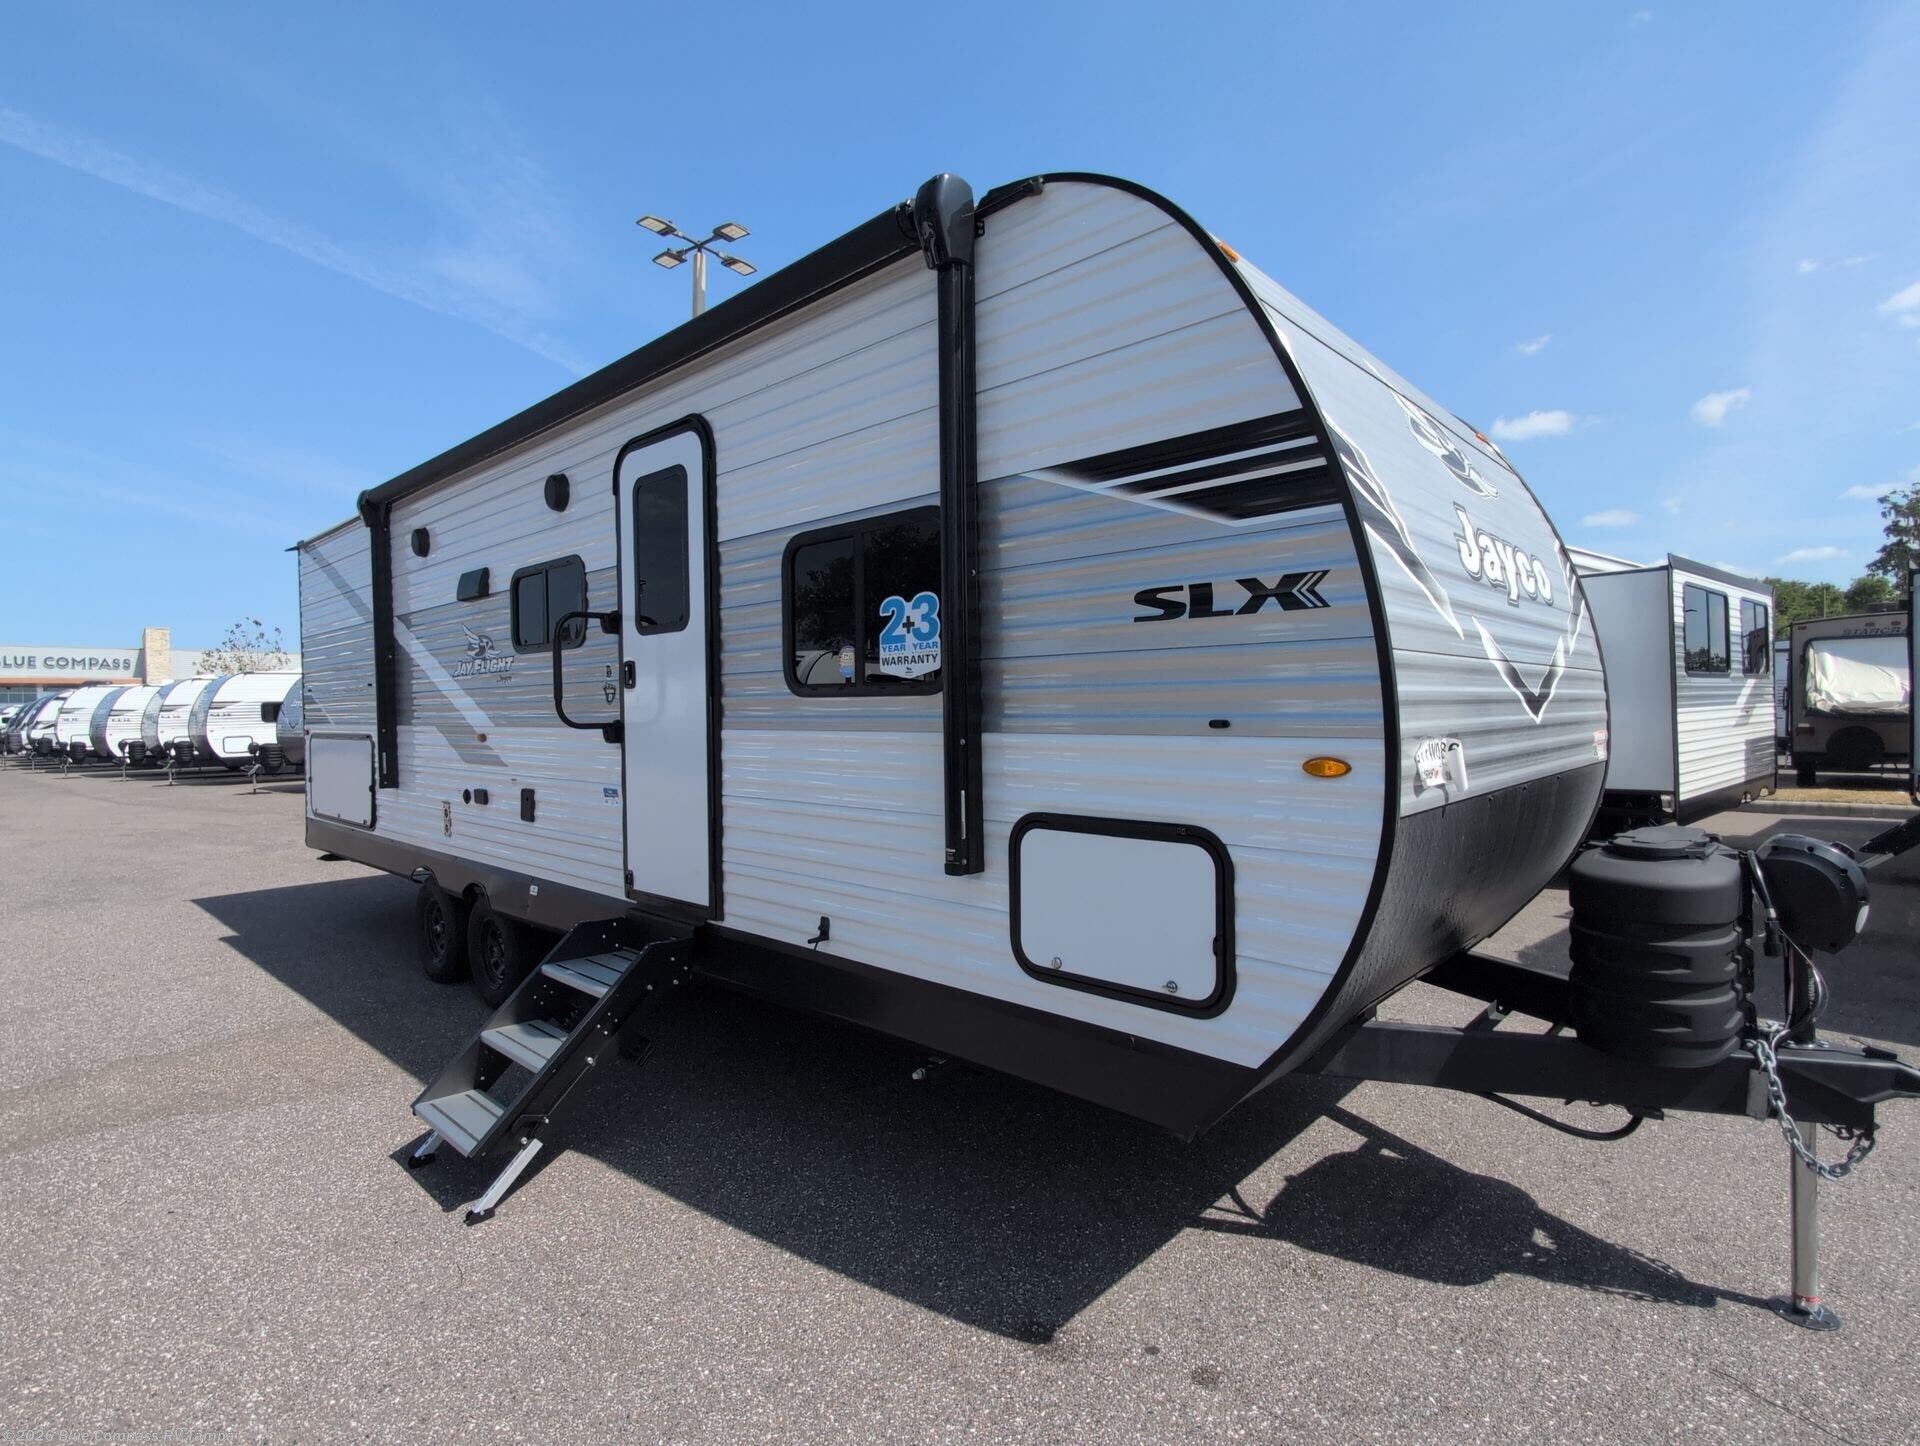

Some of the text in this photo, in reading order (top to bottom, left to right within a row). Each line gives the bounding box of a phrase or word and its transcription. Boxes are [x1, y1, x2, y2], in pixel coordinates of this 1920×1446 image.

[1453, 501, 1554, 607] Jayco
[1133, 569, 1331, 623] SLX
[881, 644, 907, 653] YEAR
[911, 641, 938, 650] YEAR
[0, 655, 132, 671] LUE COMPASS
[454, 656, 514, 677] JAY FLIGHT
[881, 653, 939, 667] WARRANTY
